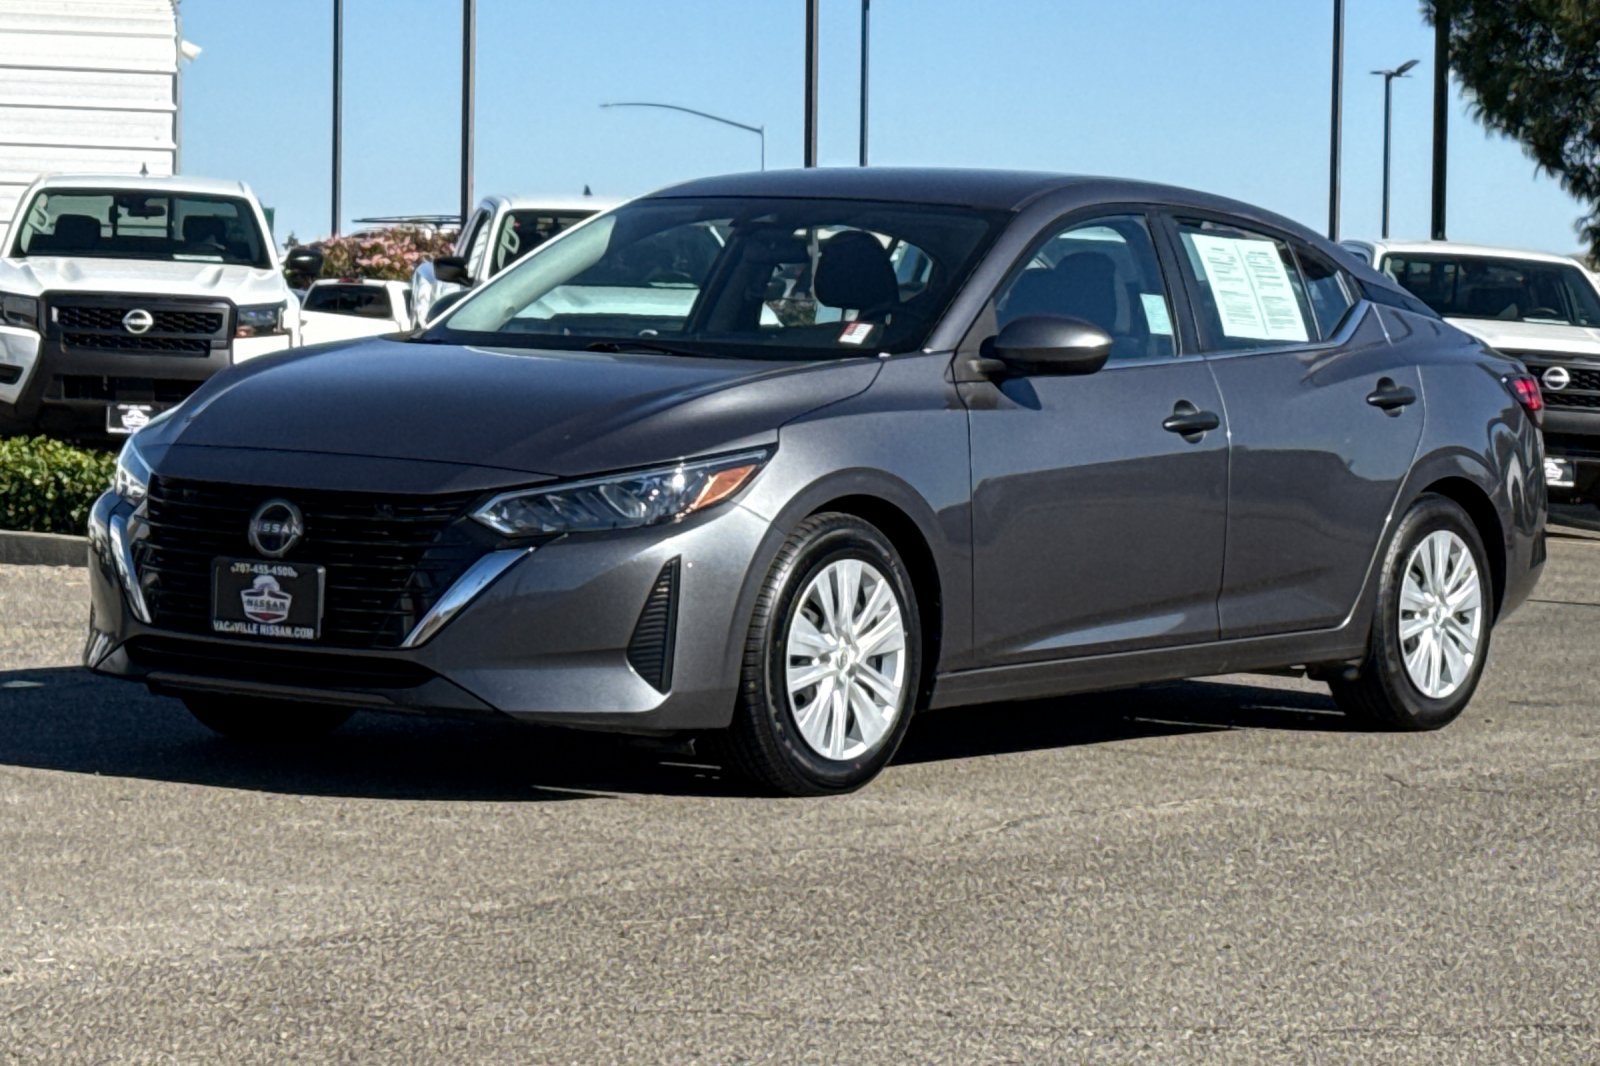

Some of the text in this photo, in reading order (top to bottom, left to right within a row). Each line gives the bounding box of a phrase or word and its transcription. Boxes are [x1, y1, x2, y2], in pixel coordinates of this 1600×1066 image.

[250, 521, 303, 536] ISSAN
[246, 598, 287, 610] NISSAN
[213, 620, 314, 639] VACAVILLE NISSAN.COM
